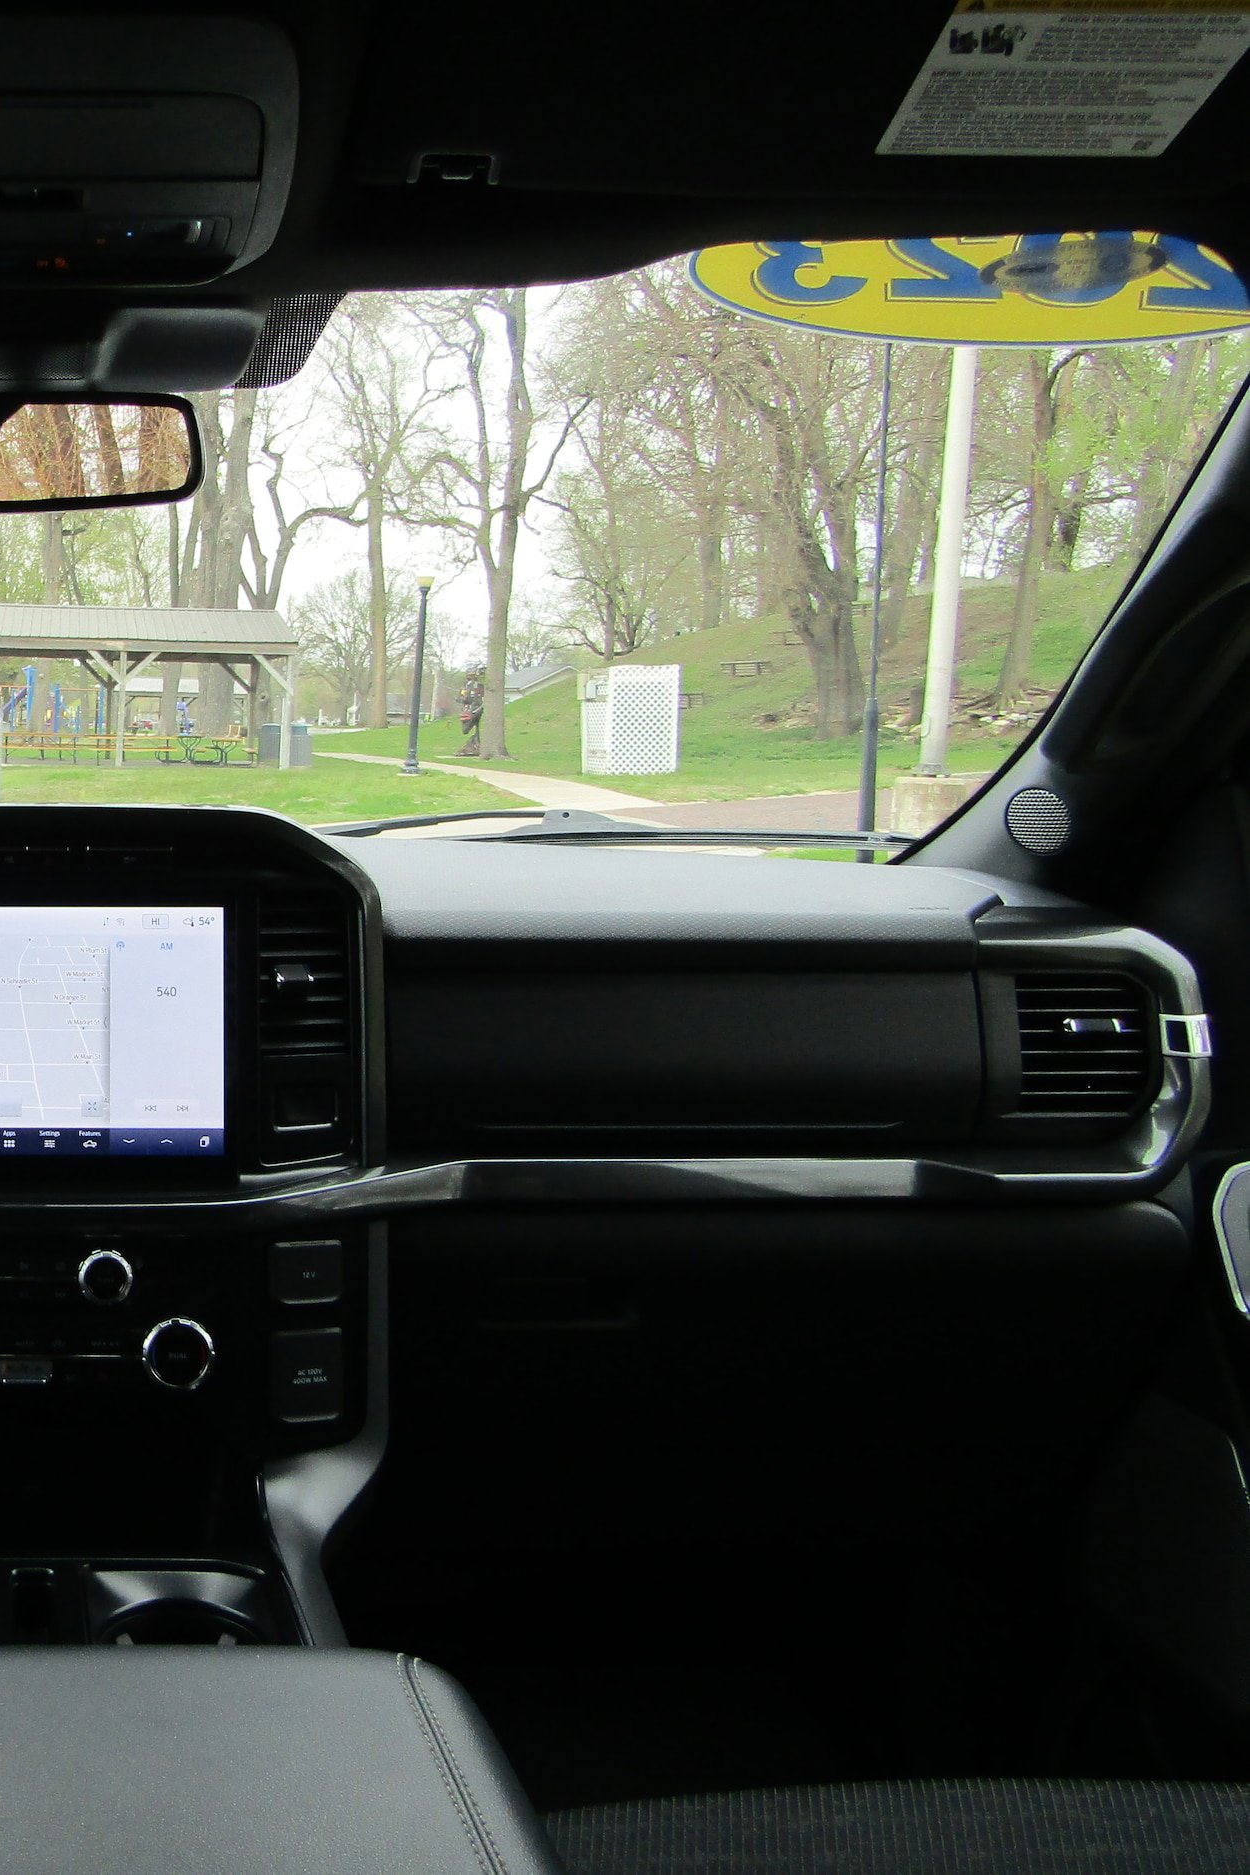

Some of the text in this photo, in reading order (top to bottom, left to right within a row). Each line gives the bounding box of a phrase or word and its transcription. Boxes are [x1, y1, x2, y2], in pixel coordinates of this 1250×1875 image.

[151, 917, 160, 926] HI
[198, 916, 215, 926] 54°
[160, 942, 173, 951] AM
[156, 986, 177, 997] 540
[2, 1130, 16, 1138] Apps
[39, 1129, 61, 1138] Settings
[78, 1129, 101, 1137] Features
